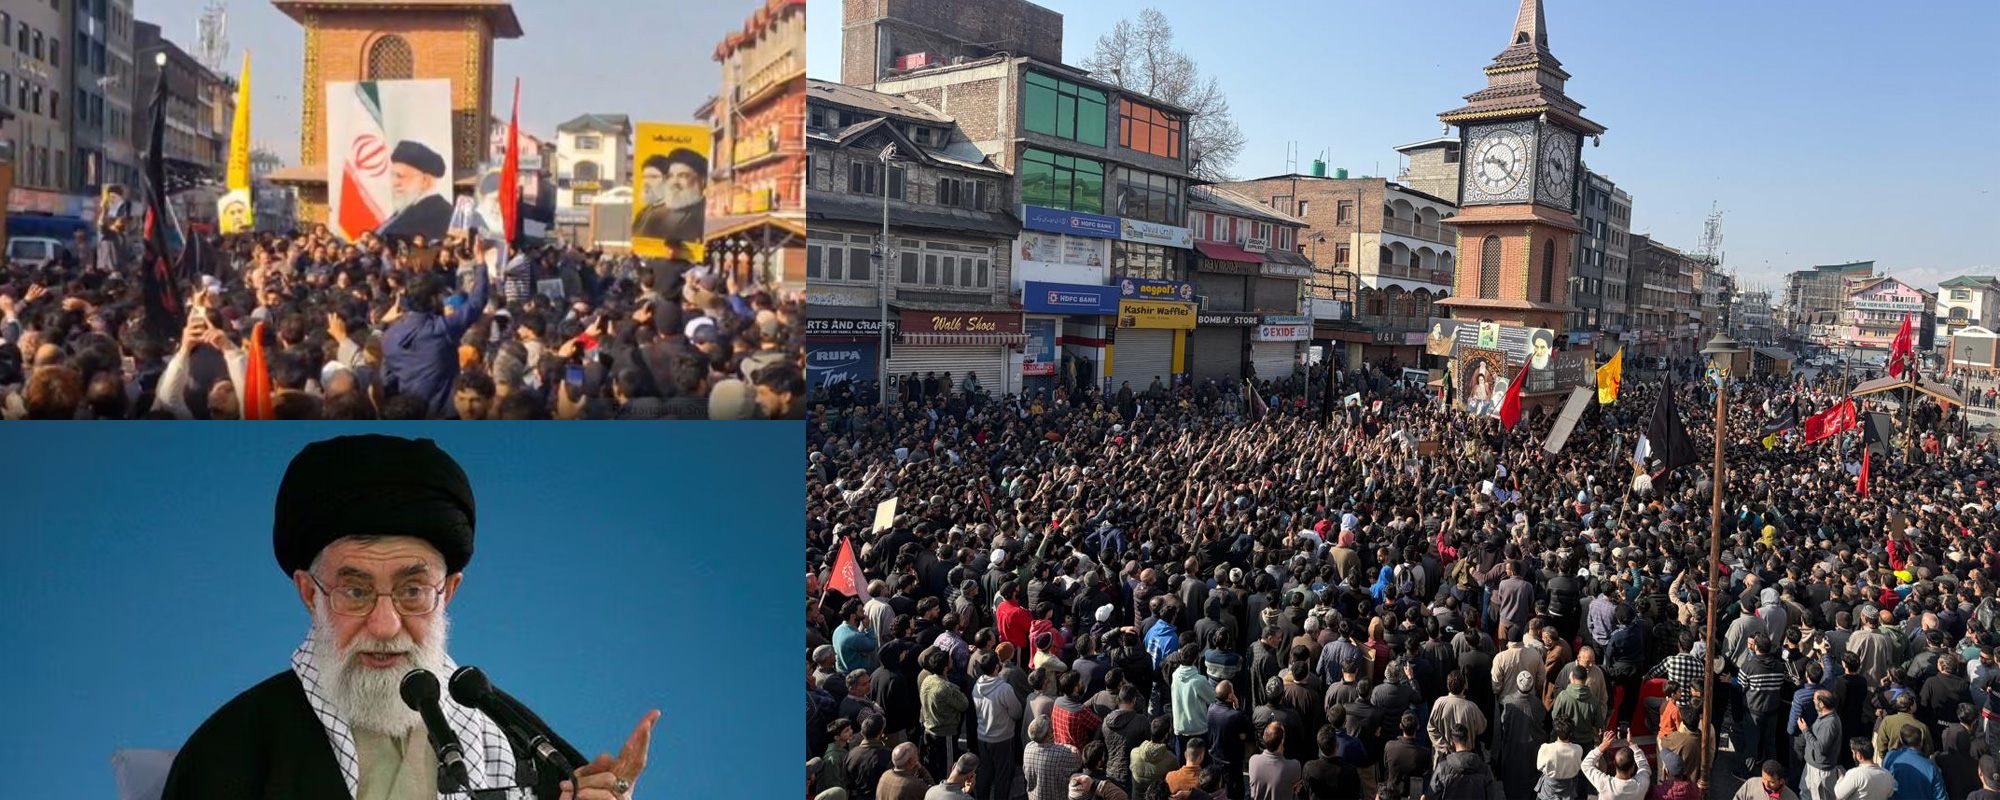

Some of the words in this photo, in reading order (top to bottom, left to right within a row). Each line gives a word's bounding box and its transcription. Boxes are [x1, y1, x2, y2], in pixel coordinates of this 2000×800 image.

[1124, 305, 1154, 315] Kashir
[1157, 306, 1189, 316] Waffles
[932, 316, 962, 331] Walk
[966, 316, 996, 331] Shoes
[1198, 315, 1231, 324] BOMBAY
[1234, 316, 1258, 324] STORE
[806, 320, 829, 330] RTS
[831, 320, 854, 330] AND
[856, 321, 895, 330] CRAFS
[1270, 327, 1295, 337] EXIDE
[1377, 333, 1383, 341] U
[1384, 333, 1389, 341] &
[816, 351, 860, 361] RUPA
[890, 376, 896, 385] P
